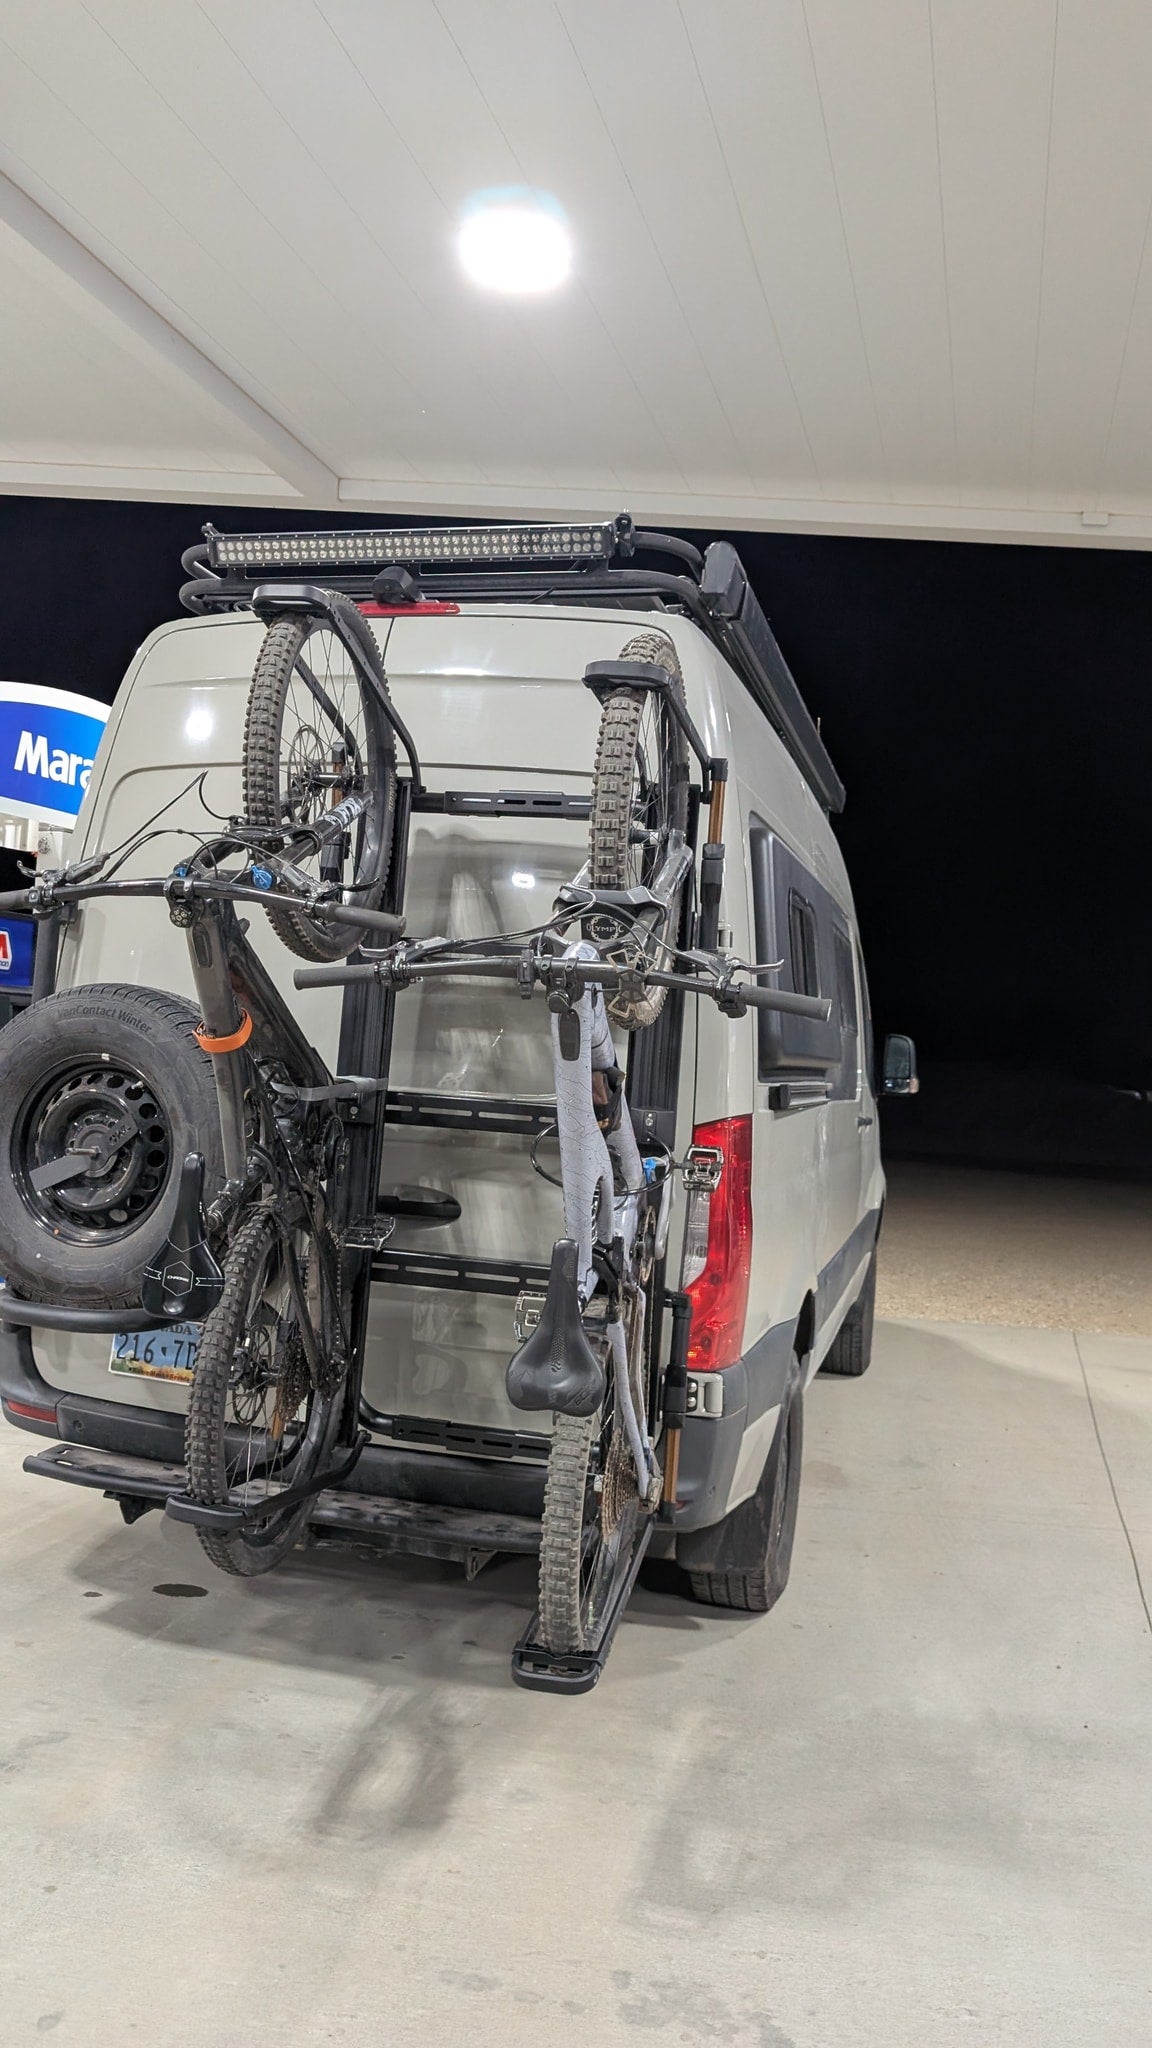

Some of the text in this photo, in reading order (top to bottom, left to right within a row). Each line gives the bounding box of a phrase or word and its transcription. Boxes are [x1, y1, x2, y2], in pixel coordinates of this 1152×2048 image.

[586, 923, 624, 933] OLYMPIC
[57, 1004, 152, 1033] VanContact Winter
[161, 1324, 193, 1336] ADA
[116, 1333, 156, 1364] 216
